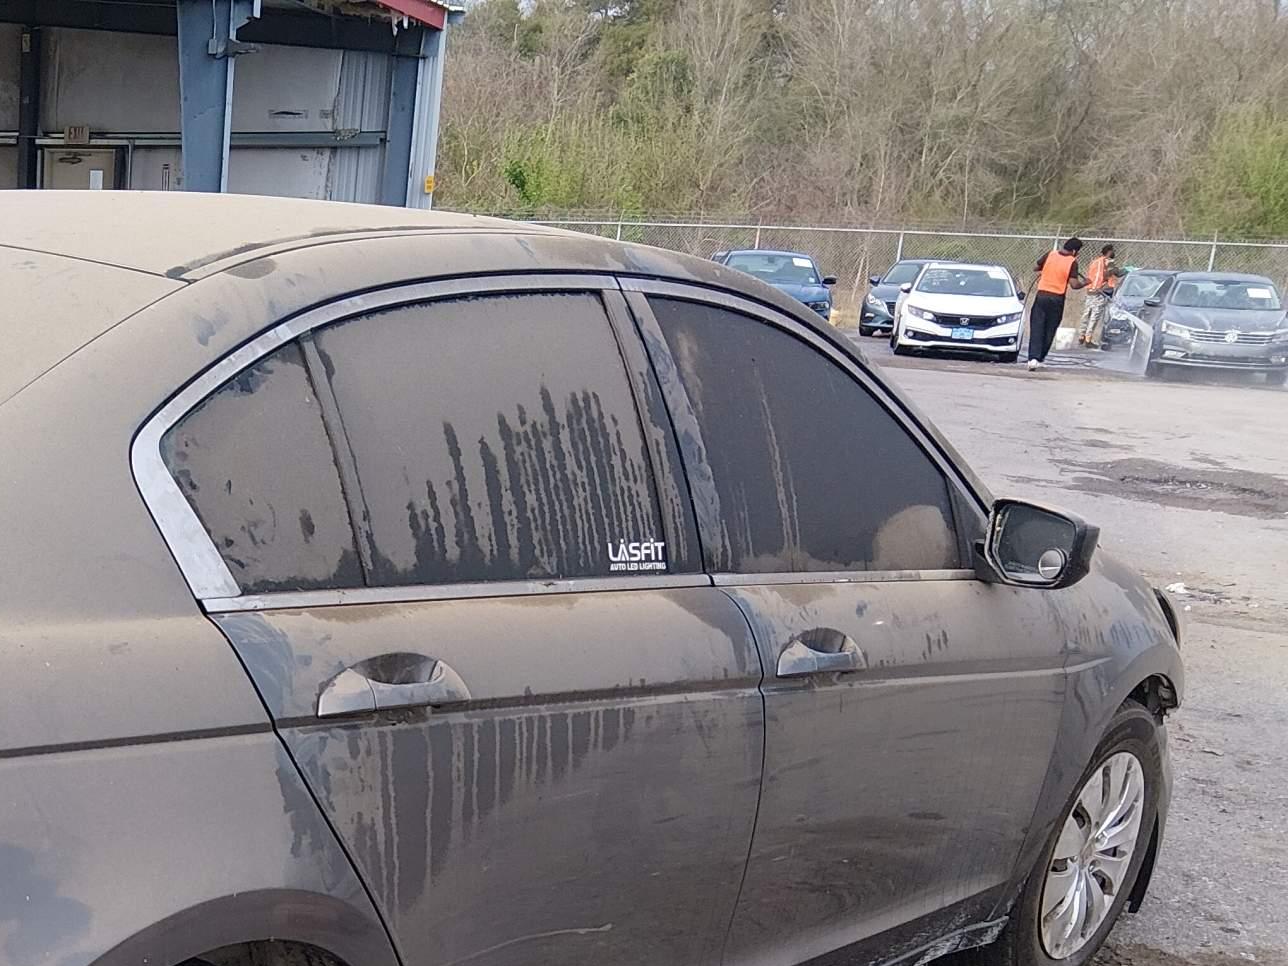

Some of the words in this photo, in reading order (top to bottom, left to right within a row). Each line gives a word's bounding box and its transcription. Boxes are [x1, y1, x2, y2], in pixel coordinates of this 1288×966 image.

[607, 537, 665, 562] LASFIT
[610, 563, 627, 571] AUTO
[627, 562, 638, 571] LED
[639, 562, 666, 570] LIGHTING
